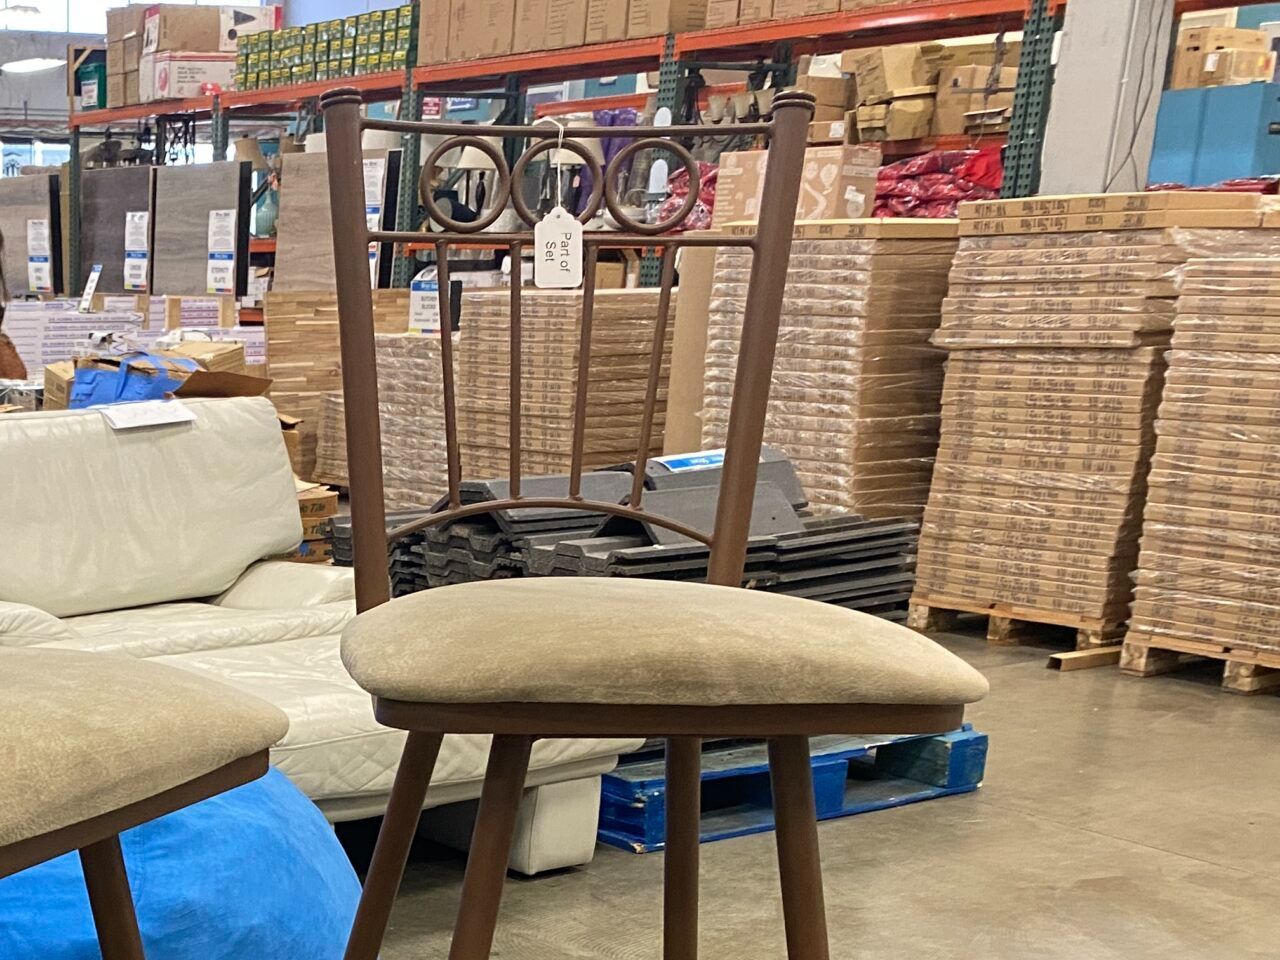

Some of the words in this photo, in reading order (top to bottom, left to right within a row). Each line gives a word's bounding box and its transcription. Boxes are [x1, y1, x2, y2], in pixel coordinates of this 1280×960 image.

[545, 241, 557, 262] Set
[560, 232, 572, 257] Part
[560, 260, 571, 273] of
